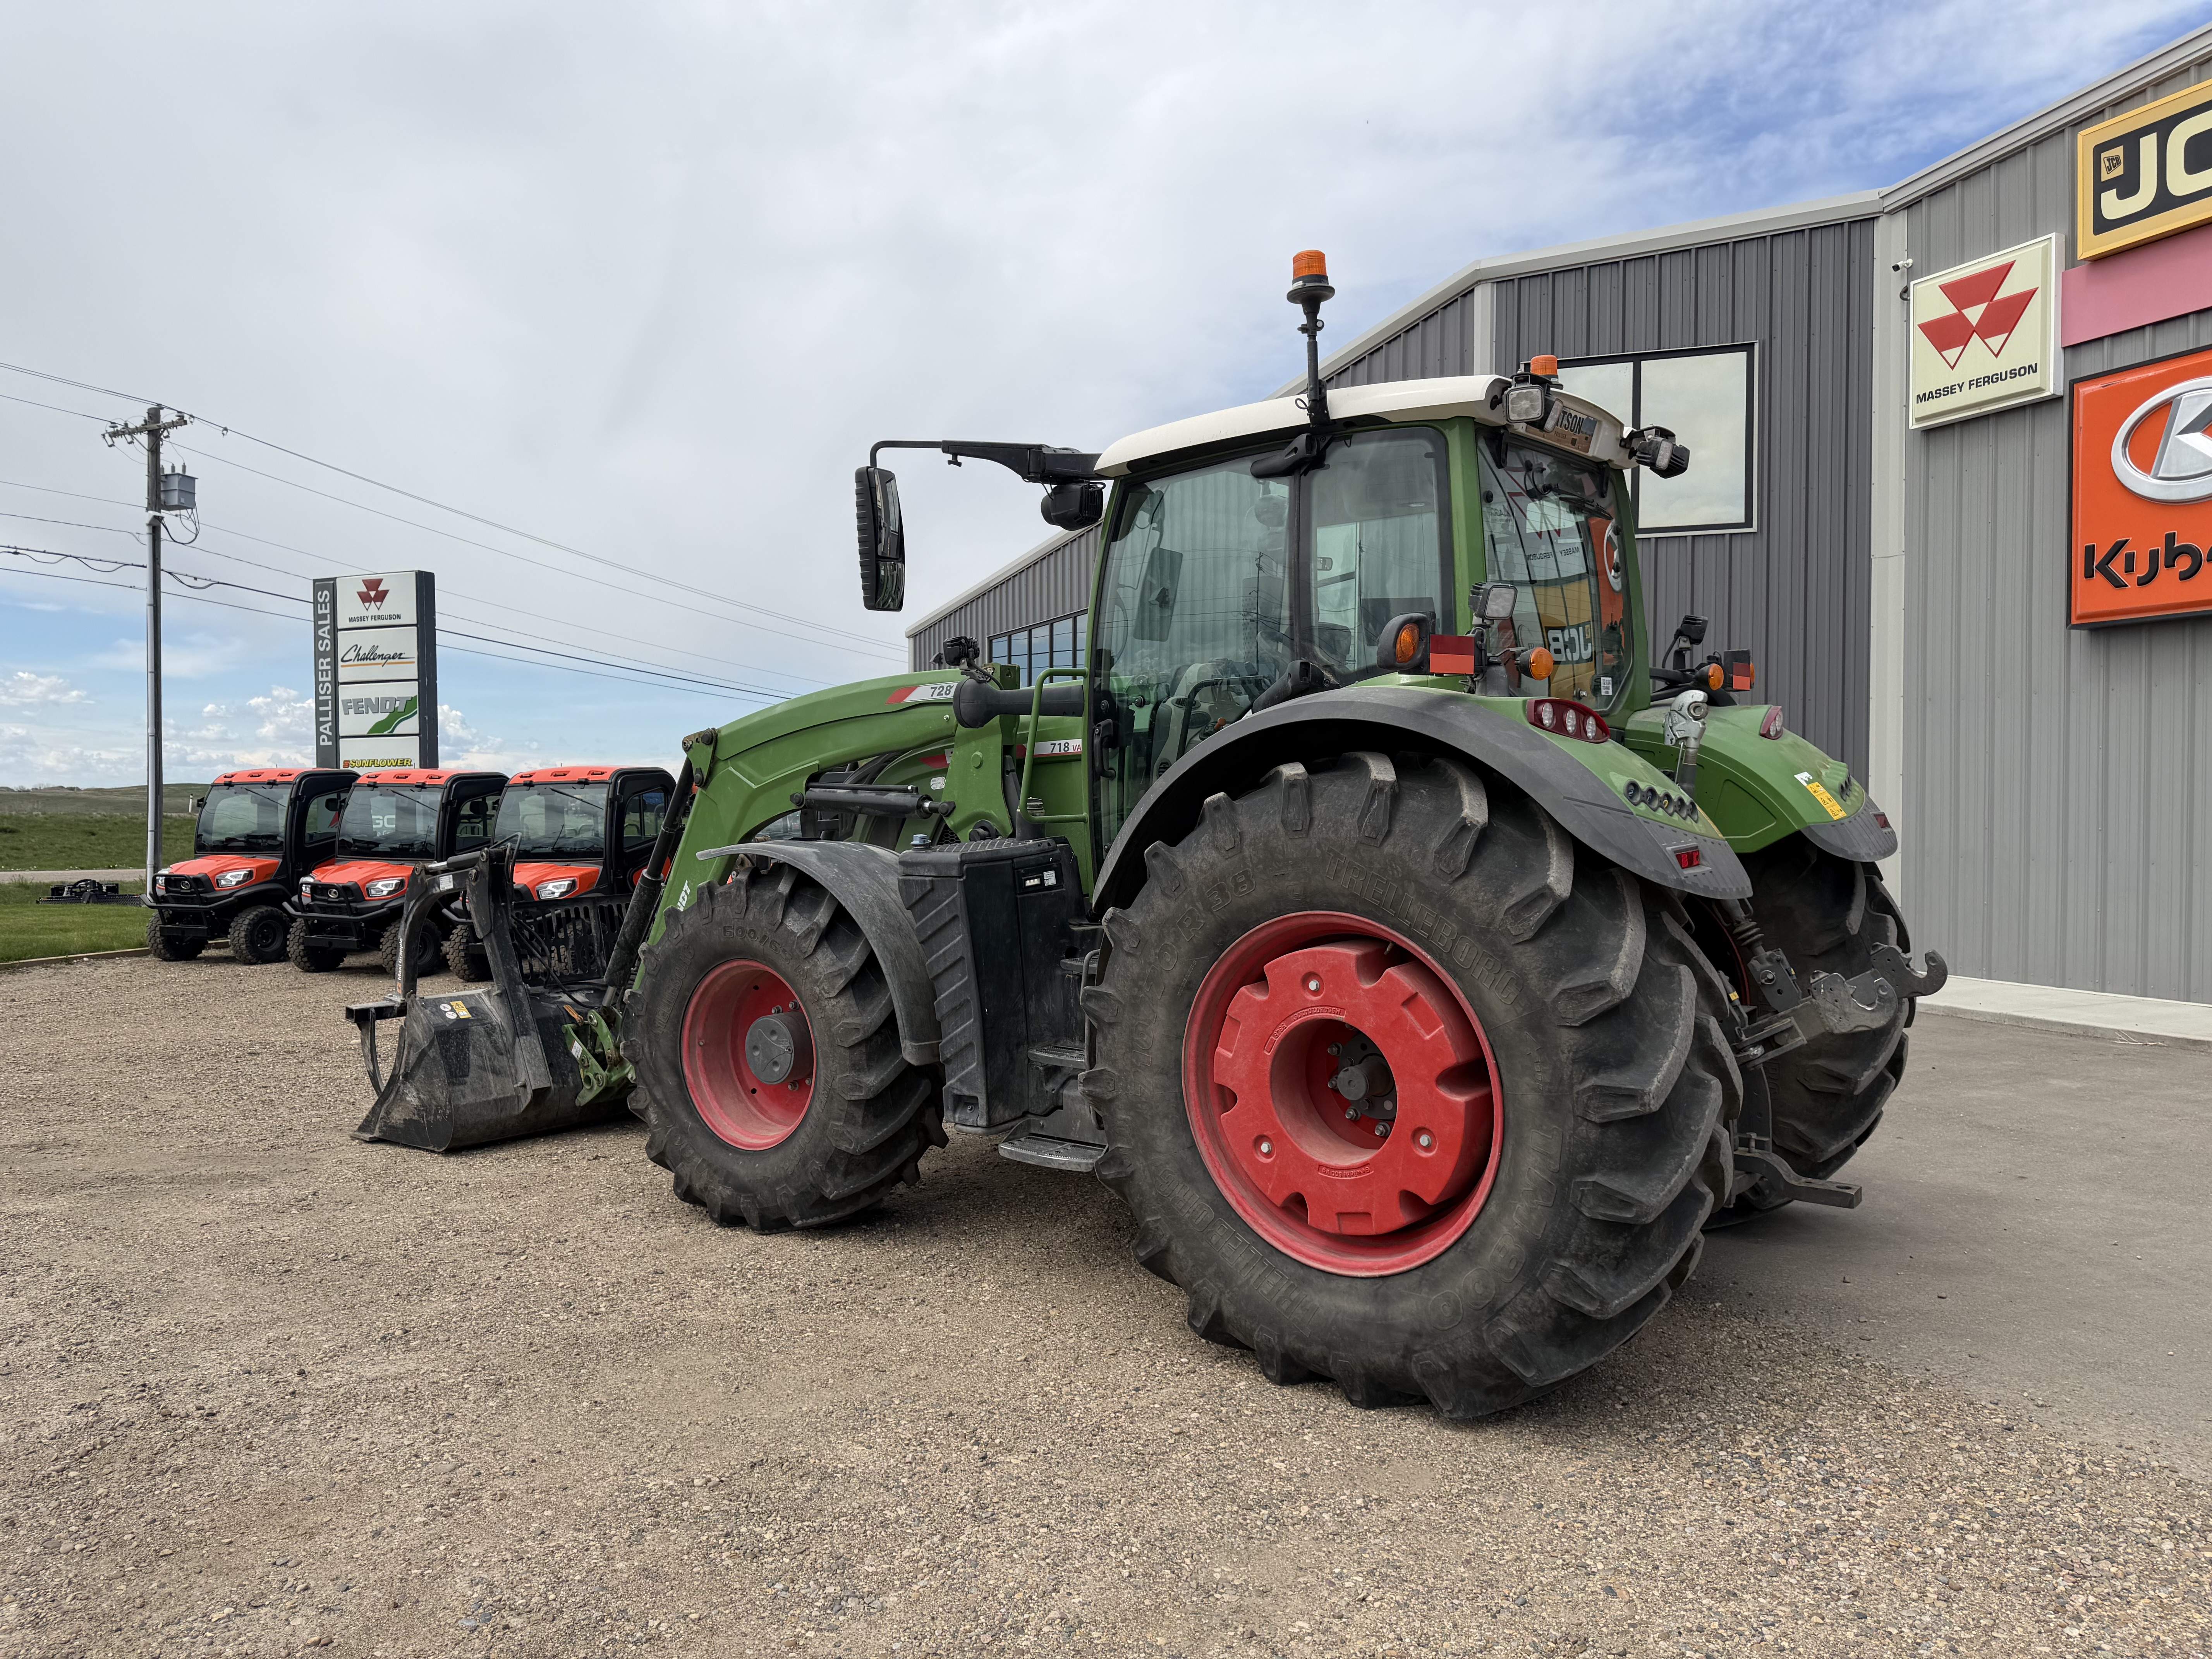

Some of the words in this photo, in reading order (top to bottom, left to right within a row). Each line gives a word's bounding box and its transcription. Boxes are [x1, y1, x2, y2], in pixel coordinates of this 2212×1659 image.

[2107, 156, 2120, 172] JCB
[1916, 381, 1965, 404] MASSEY
[1968, 362, 2037, 390] FERGUSON
[1556, 410, 1584, 435] TSON
[2084, 531, 2212, 589] Kub
[318, 589, 330, 651] SALES
[341, 644, 416, 667] Challenger
[319, 658, 333, 746] PALLISER
[930, 685, 952, 697] 728
[341, 696, 413, 715] FENDT
[1050, 742, 1070, 753] 718
[349, 758, 412, 768] SUNFLOWER
[1325, 847, 1524, 1005] TRELLEBORG
[1155, 1169, 1319, 1338] TRELLEBORG
